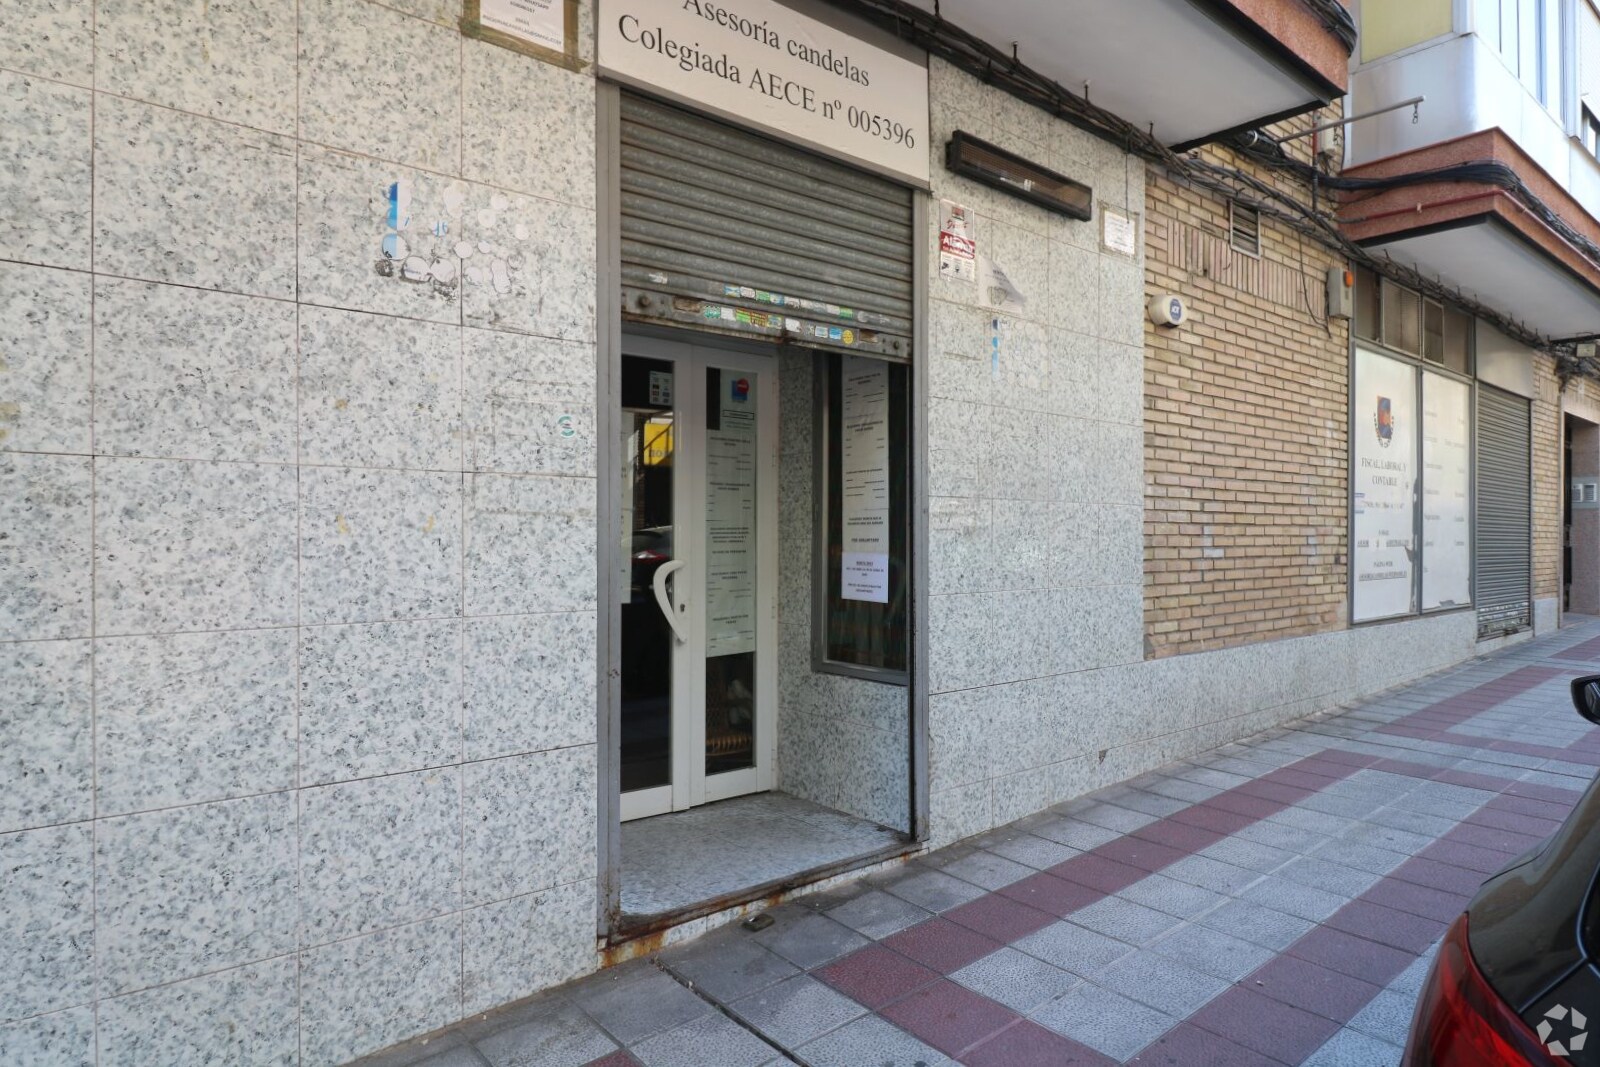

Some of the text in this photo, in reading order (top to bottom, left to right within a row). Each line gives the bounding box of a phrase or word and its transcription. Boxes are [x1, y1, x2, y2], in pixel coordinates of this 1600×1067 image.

[618, 14, 742, 84] Colegiada
[749, 68, 816, 113] AECE
[848, 105, 915, 149] 005396
[683, 0, 870, 87] Asesoría candelas
